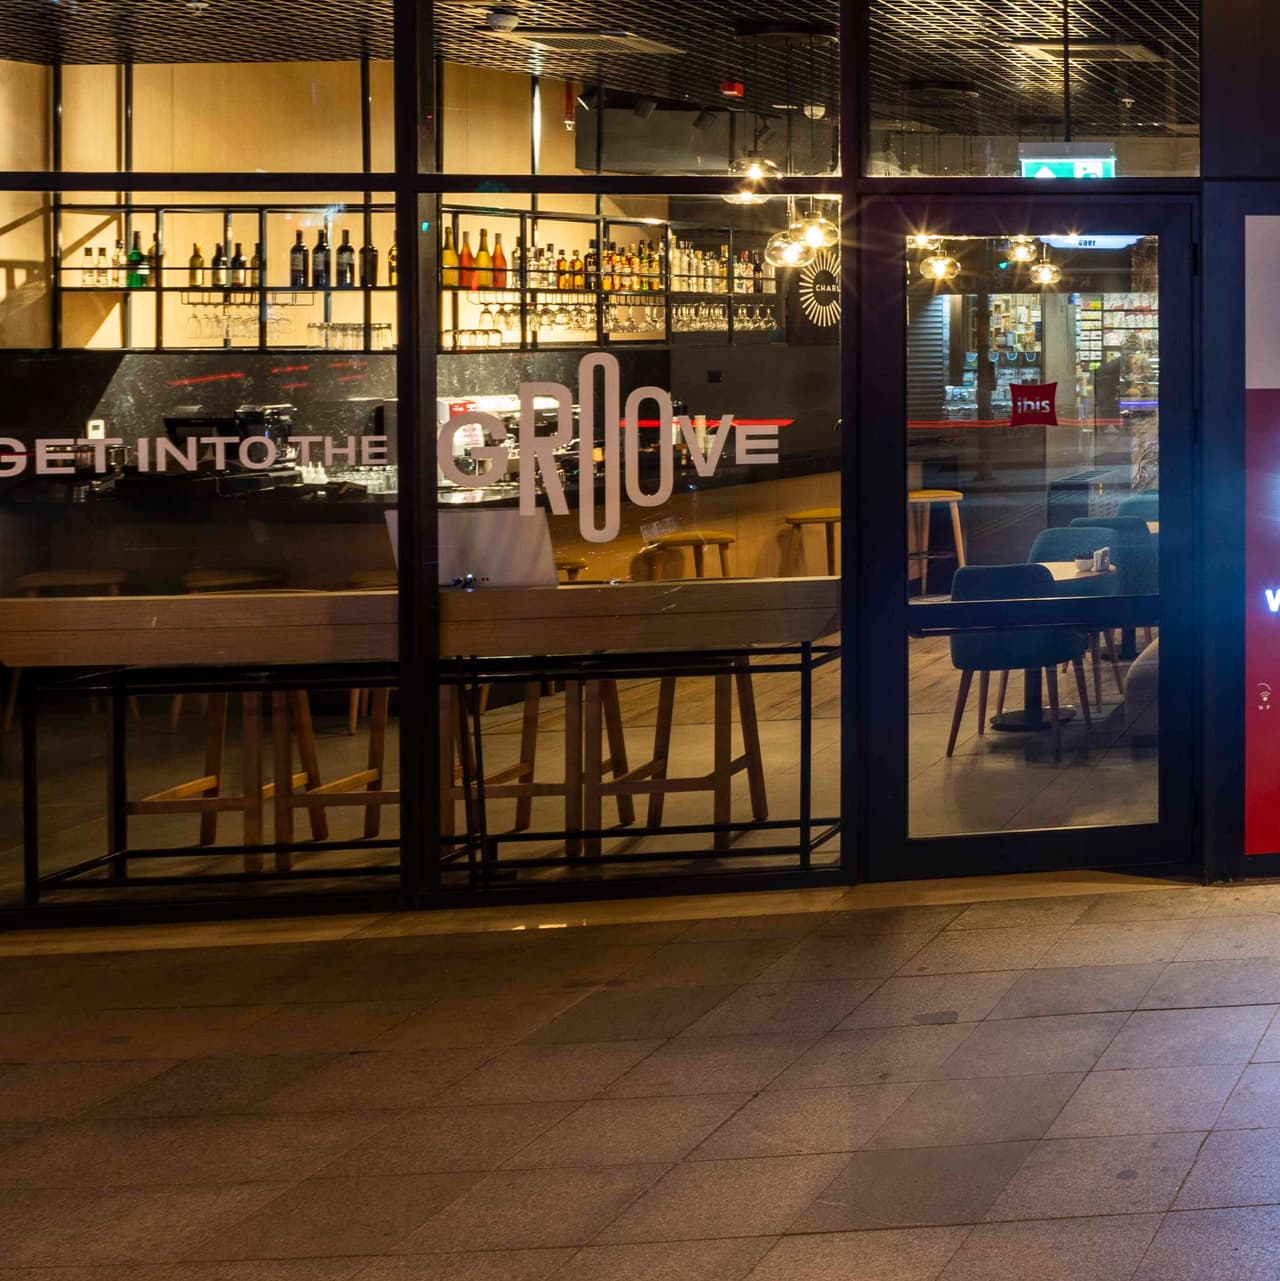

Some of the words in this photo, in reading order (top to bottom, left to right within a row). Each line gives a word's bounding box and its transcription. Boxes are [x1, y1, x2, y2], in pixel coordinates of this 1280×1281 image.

[0, 437, 123, 478] GET
[138, 436, 278, 473] INTO
[288, 435, 388, 466] THE
[439, 352, 779, 543] GROOVE
[1017, 397, 1050, 414] ibis
